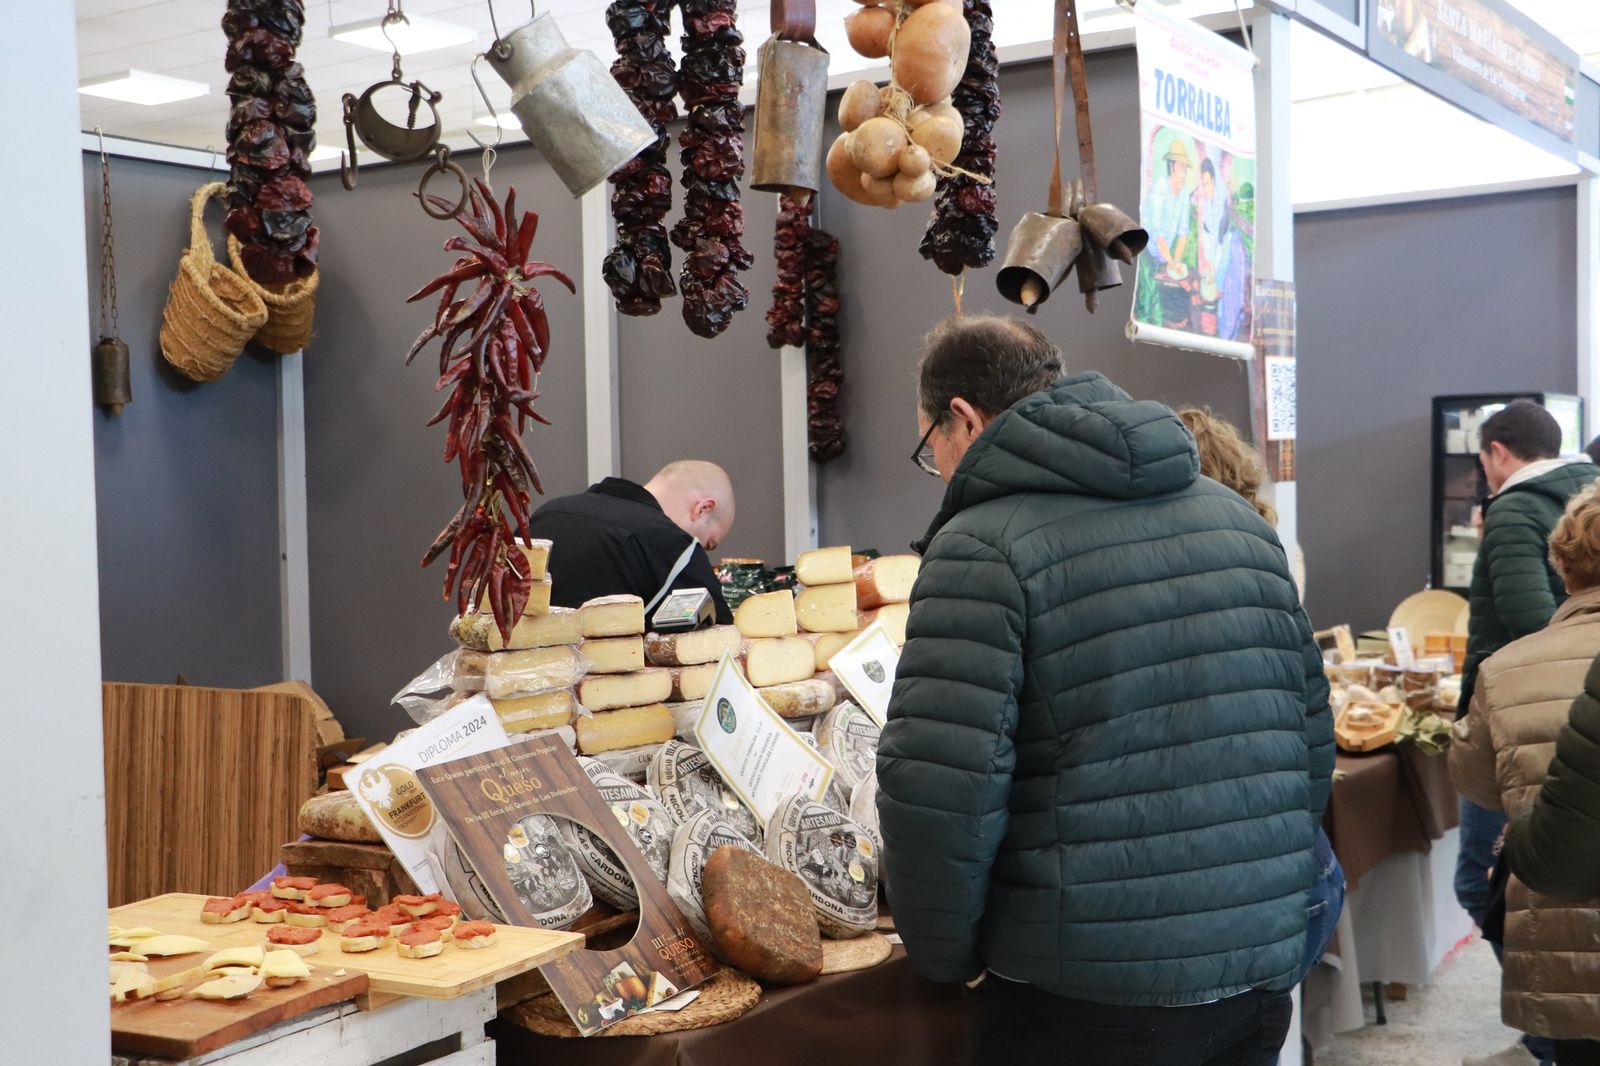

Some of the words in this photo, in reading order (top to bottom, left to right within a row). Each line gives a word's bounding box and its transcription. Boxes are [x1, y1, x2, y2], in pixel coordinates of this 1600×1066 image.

[1155, 68, 1231, 139] TORRALBA
[418, 731, 464, 763] DIPLOMA
[462, 715, 488, 737] 2024
[638, 754, 655, 763] CUR
[664, 759, 674, 780] queso
[677, 752, 706, 776] ARTESAN
[445, 771, 464, 781] Queso
[395, 780, 414, 795] GOLD
[480, 777, 542, 804] Queso
[389, 792, 426, 819] FRANKFURT
[801, 814, 841, 830] ARTESANO
[786, 840, 797, 874] NICOL
[590, 851, 635, 890] CARDONA
[538, 913, 567, 926] DONA
[651, 937, 664, 950] III
[659, 938, 694, 960] QUESO
